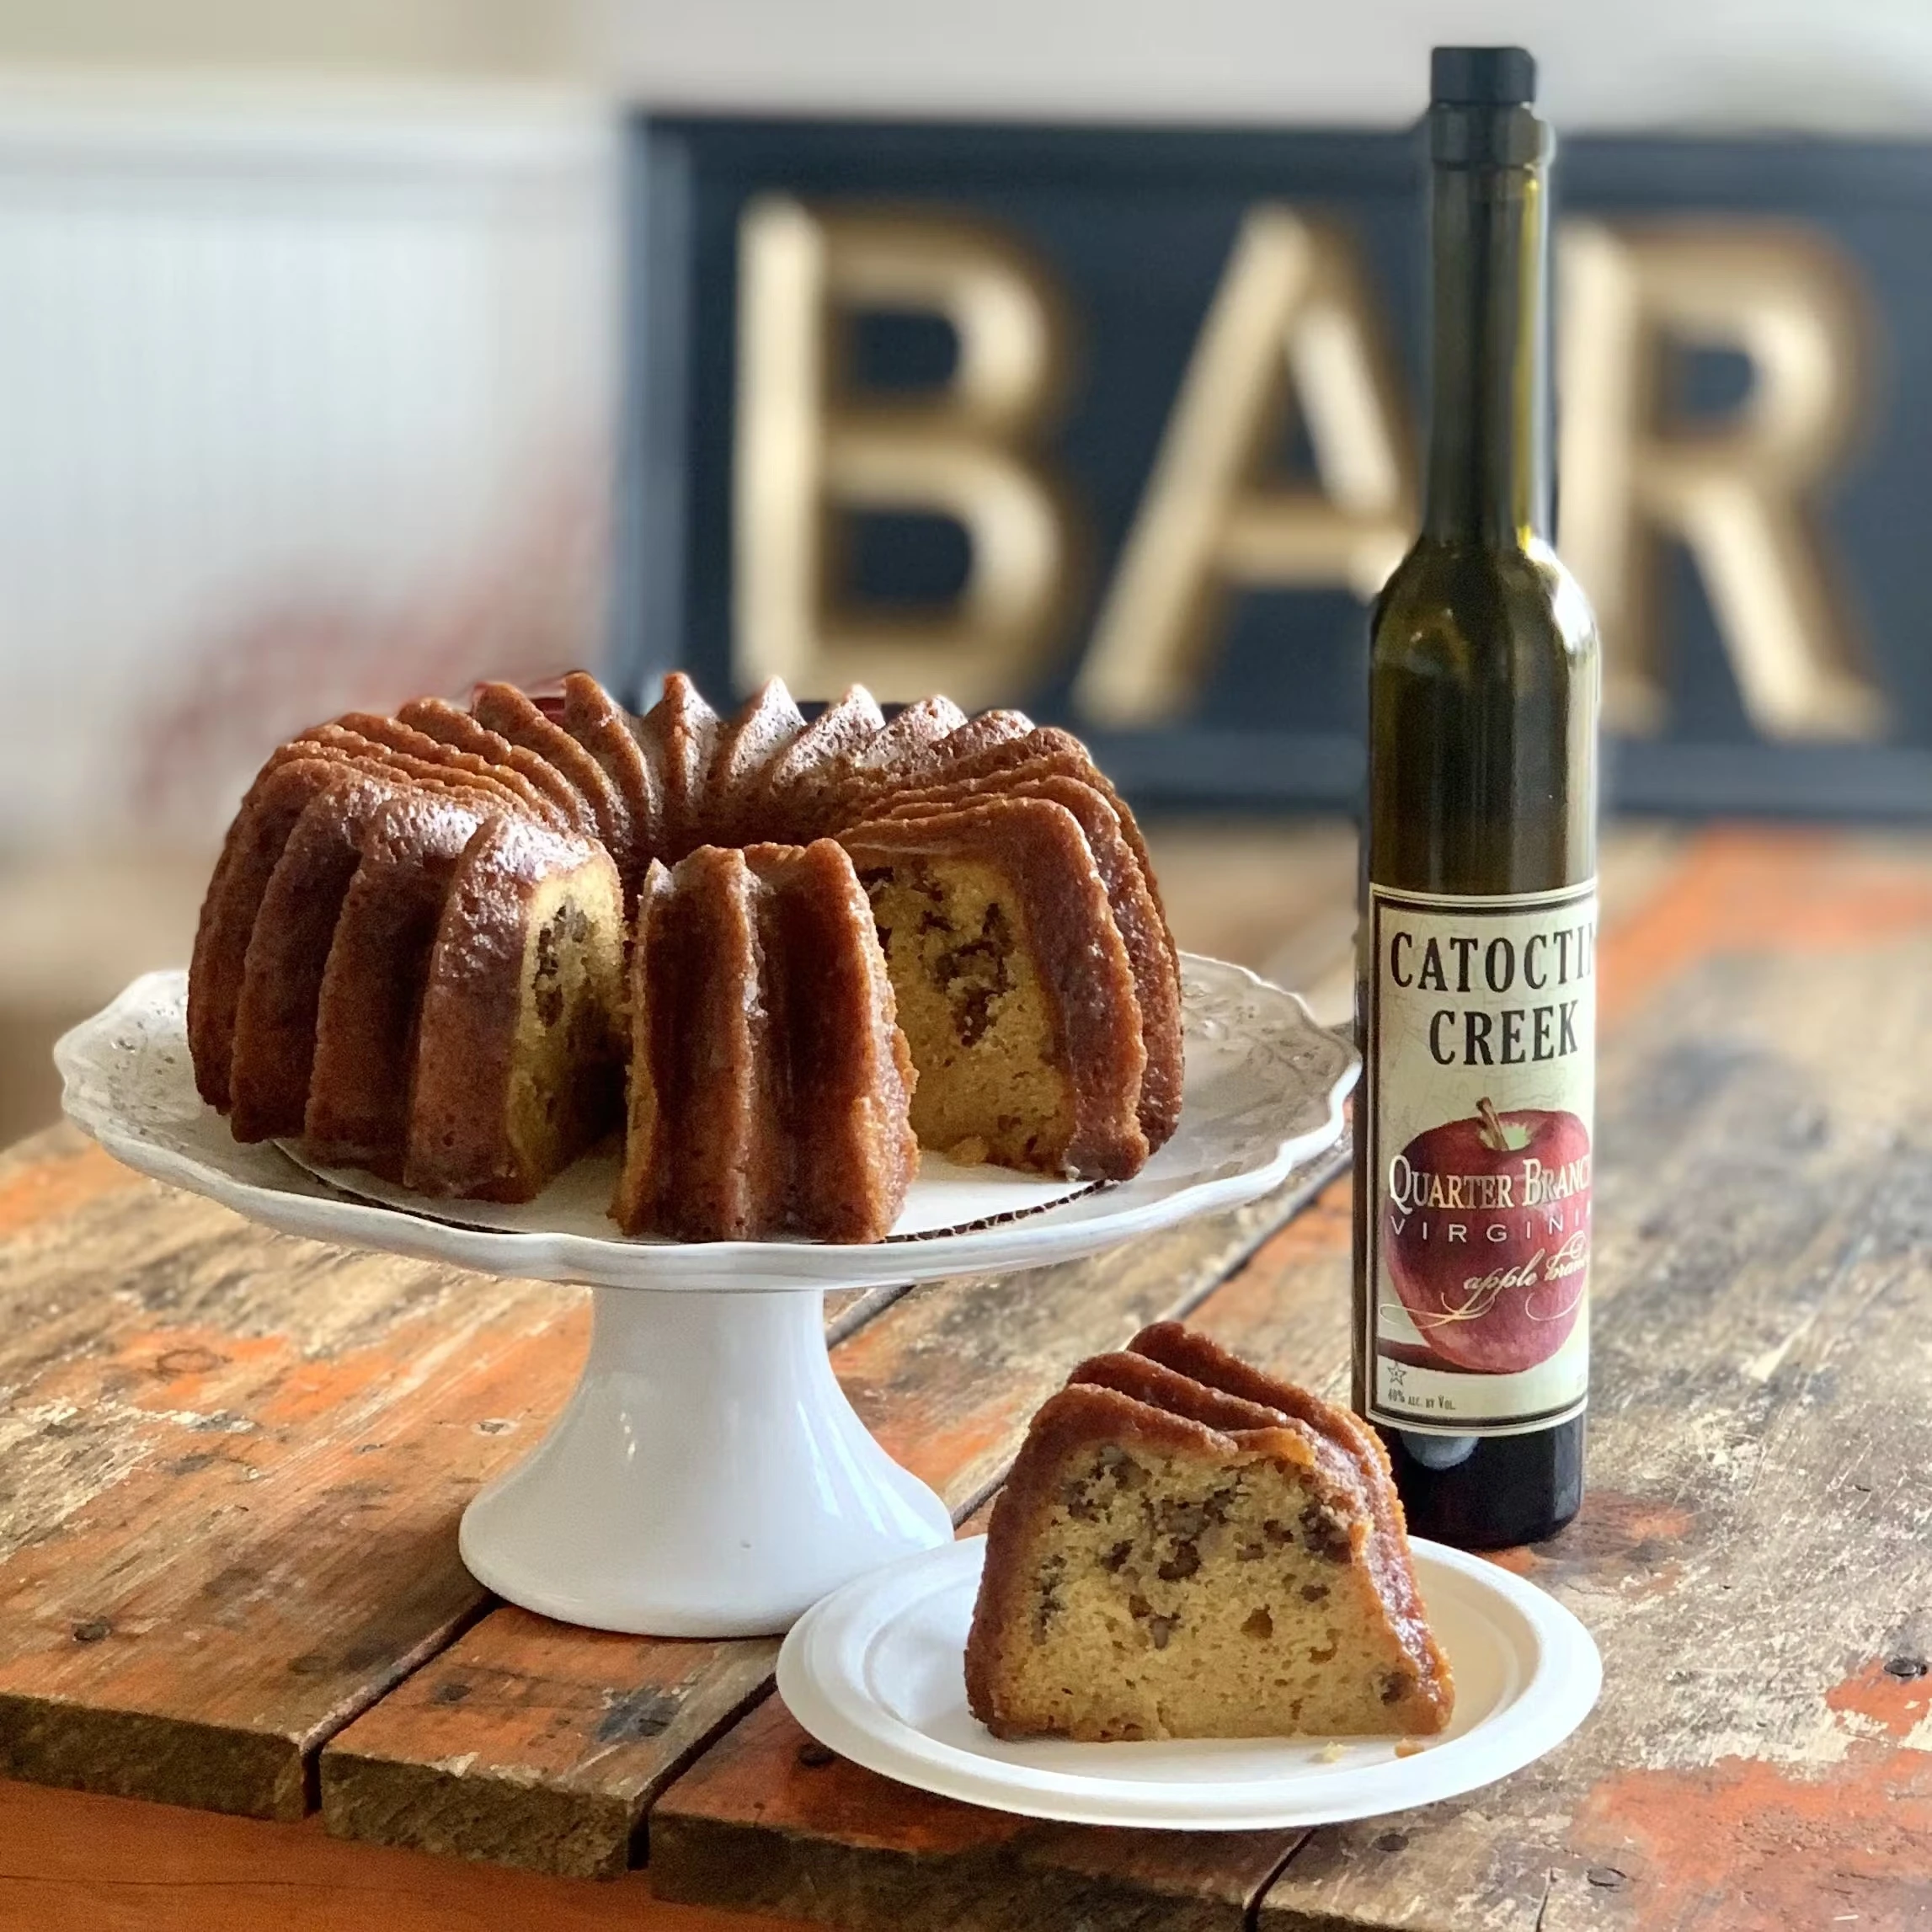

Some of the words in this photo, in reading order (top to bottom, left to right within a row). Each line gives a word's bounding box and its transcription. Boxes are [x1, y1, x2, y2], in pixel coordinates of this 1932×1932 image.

[729, 194, 1887, 741] BAR
[1390, 922, 1593, 993] CATOCTI
[1429, 1000, 1578, 1065] CREEK
[1522, 1155, 1590, 1207] BRANC
[1441, 1247, 1545, 1318] apple
